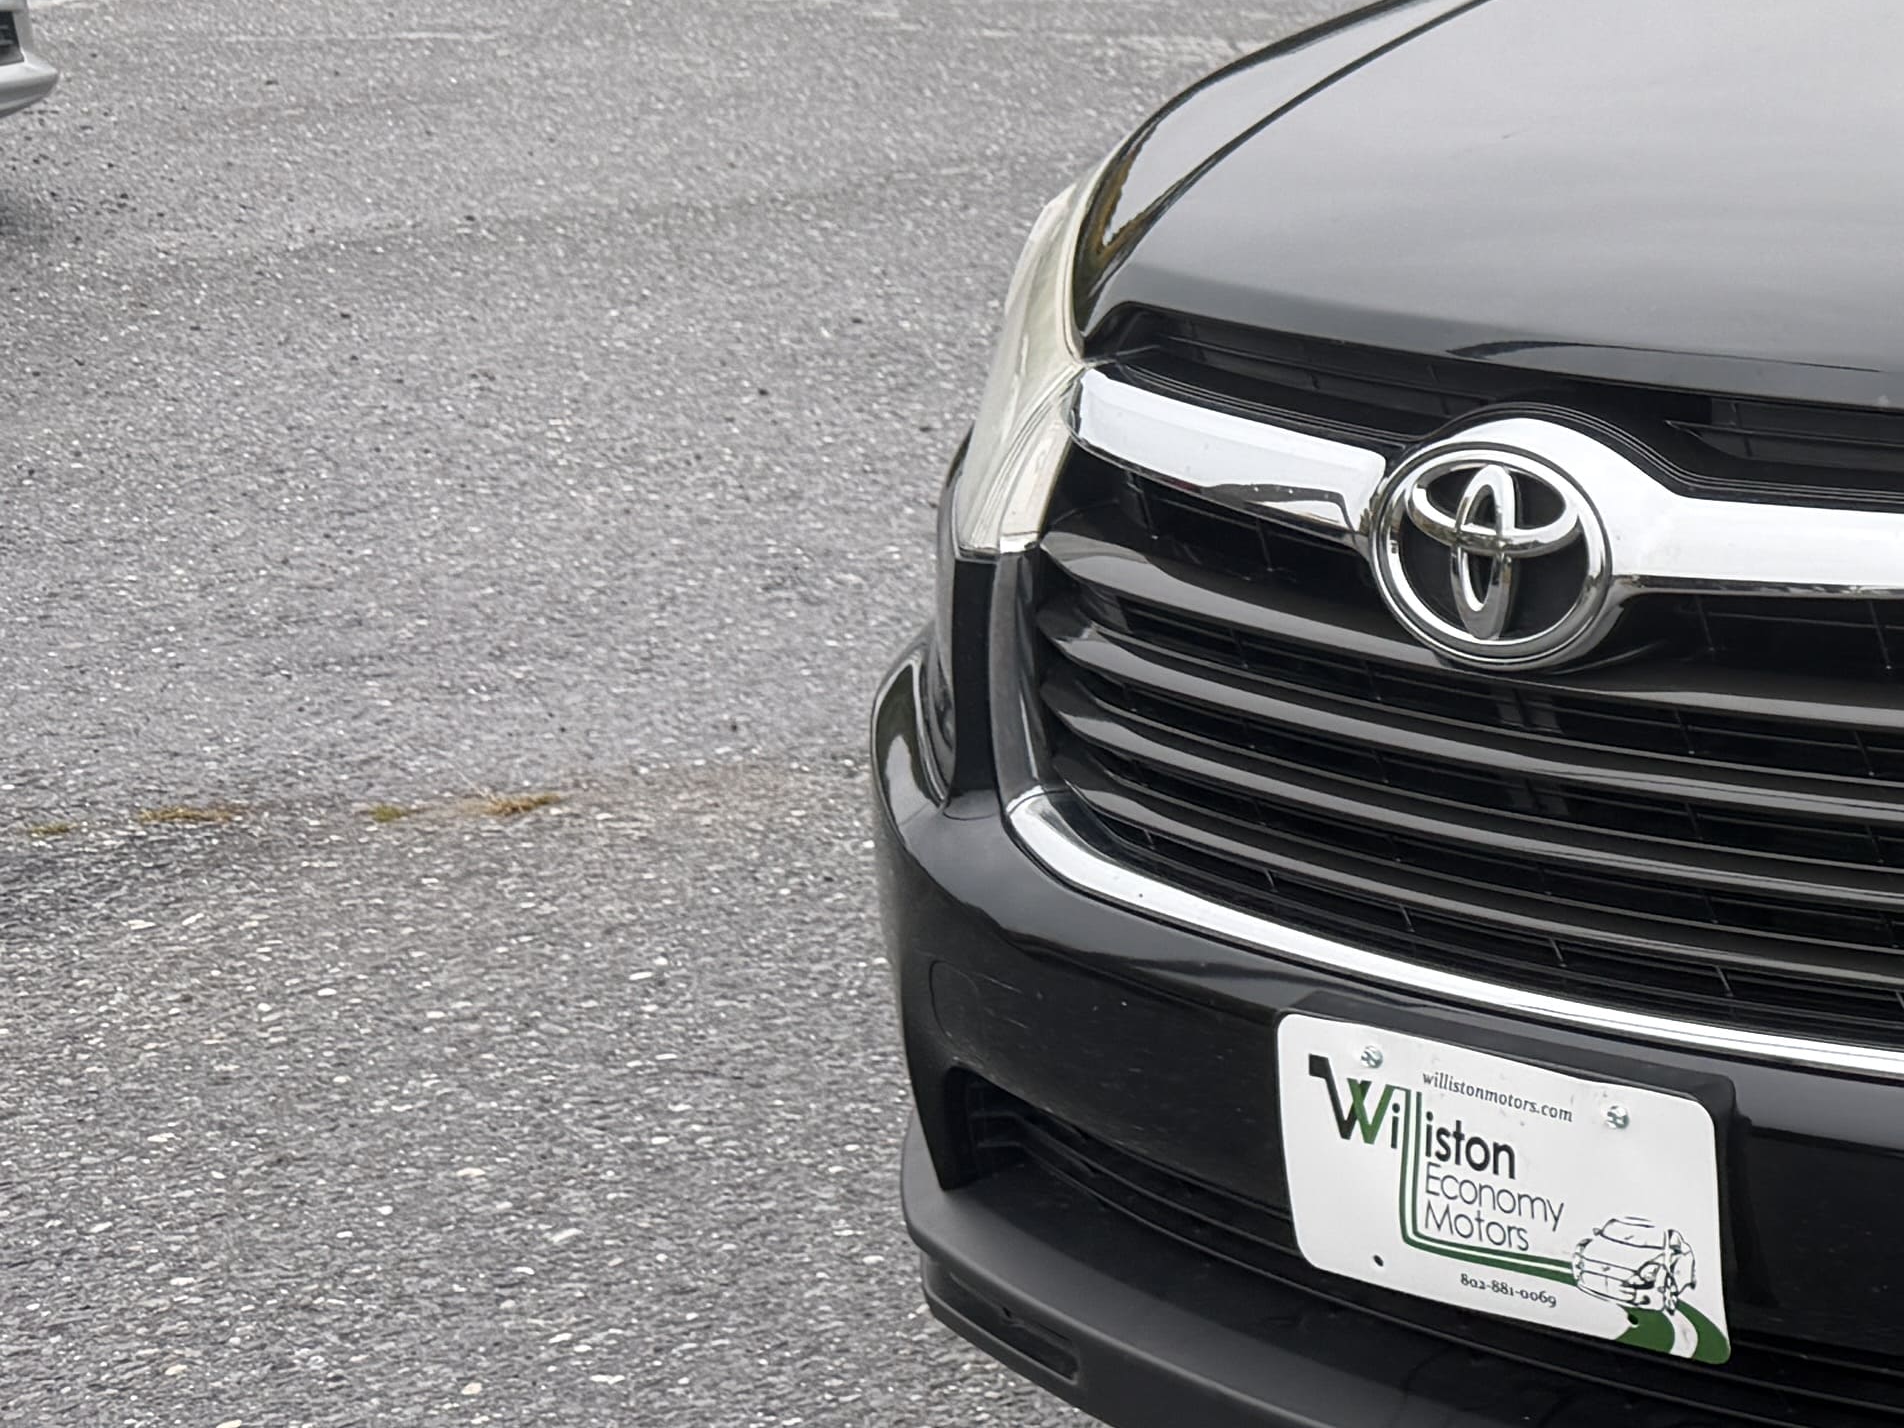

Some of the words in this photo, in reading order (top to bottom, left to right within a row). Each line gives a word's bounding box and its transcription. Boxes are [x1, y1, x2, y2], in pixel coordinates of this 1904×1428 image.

[1308, 1052, 1517, 1181] Williston
[1422, 1071, 1574, 1123] willistonmotors.com
[1425, 1161, 1565, 1233] Economy
[1424, 1199, 1530, 1252] Motors
[1460, 1273, 1557, 1309] 802-881-0069
